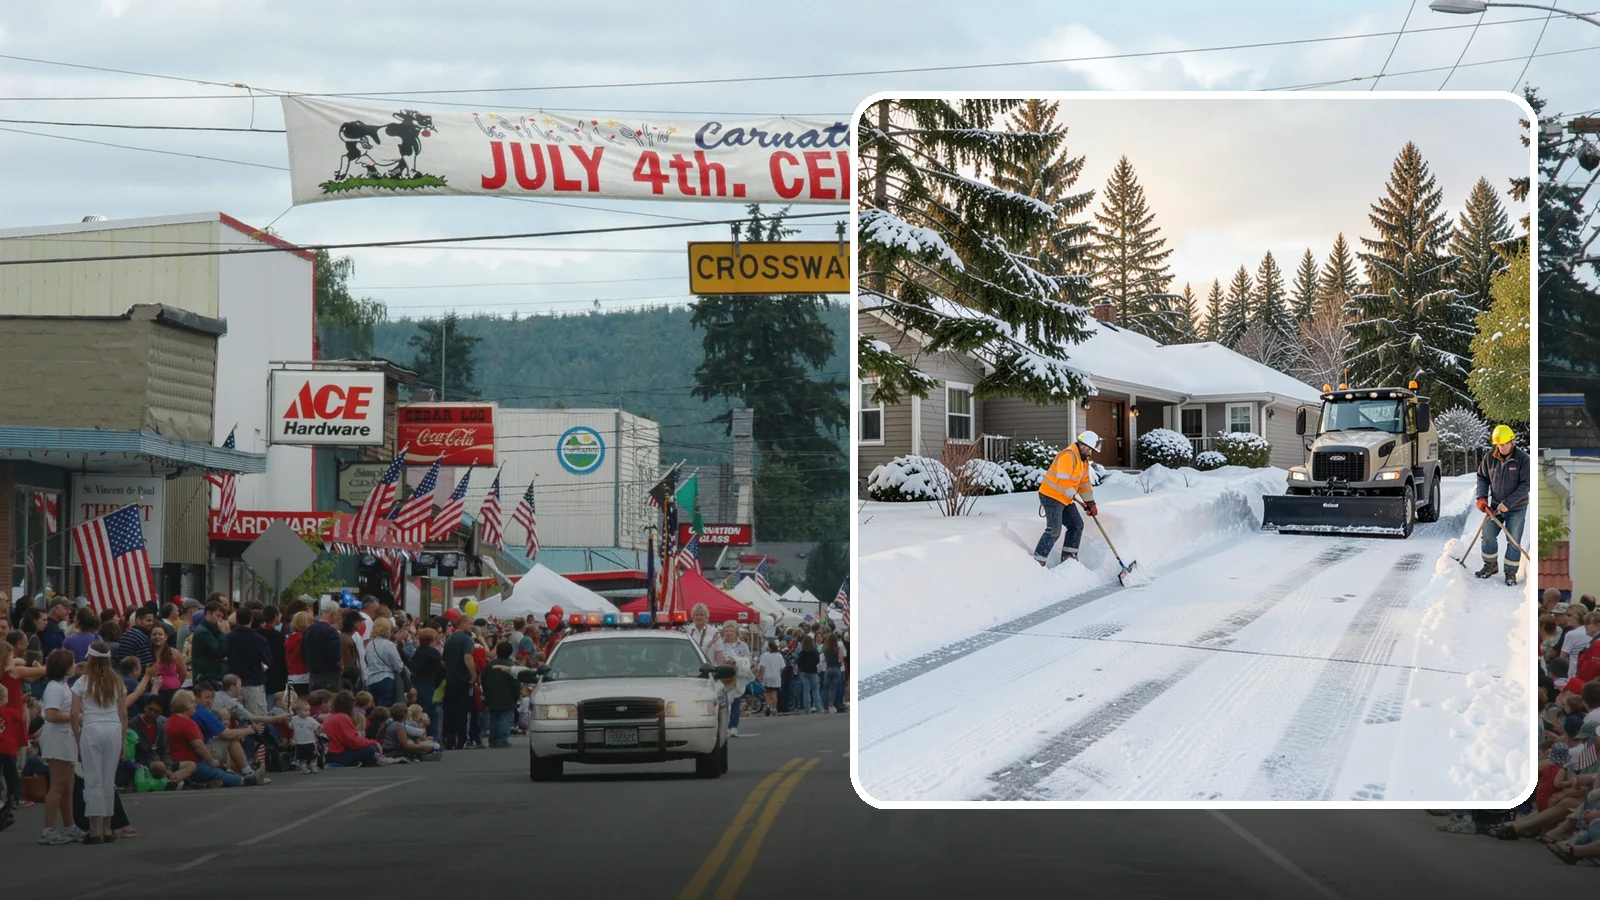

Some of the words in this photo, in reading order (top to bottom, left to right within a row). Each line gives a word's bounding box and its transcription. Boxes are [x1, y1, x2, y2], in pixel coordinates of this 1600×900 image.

[481, 141, 605, 192] JULY
[632, 150, 746, 197] 4th.
[697, 253, 850, 280] CROSSWA
[282, 380, 373, 420] ACE
[405, 409, 452, 422] CEDAR
[461, 409, 485, 421] LOG
[283, 421, 371, 437] Hardware
[416, 428, 477, 447] Coca-Cola
[83, 486, 93, 494] St.
[95, 485, 124, 495] Vincent
[126, 486, 135, 494] de
[137, 486, 155, 495] Paul
[688, 526, 741, 535] CRNATION
[699, 535, 730, 543] GLASS
